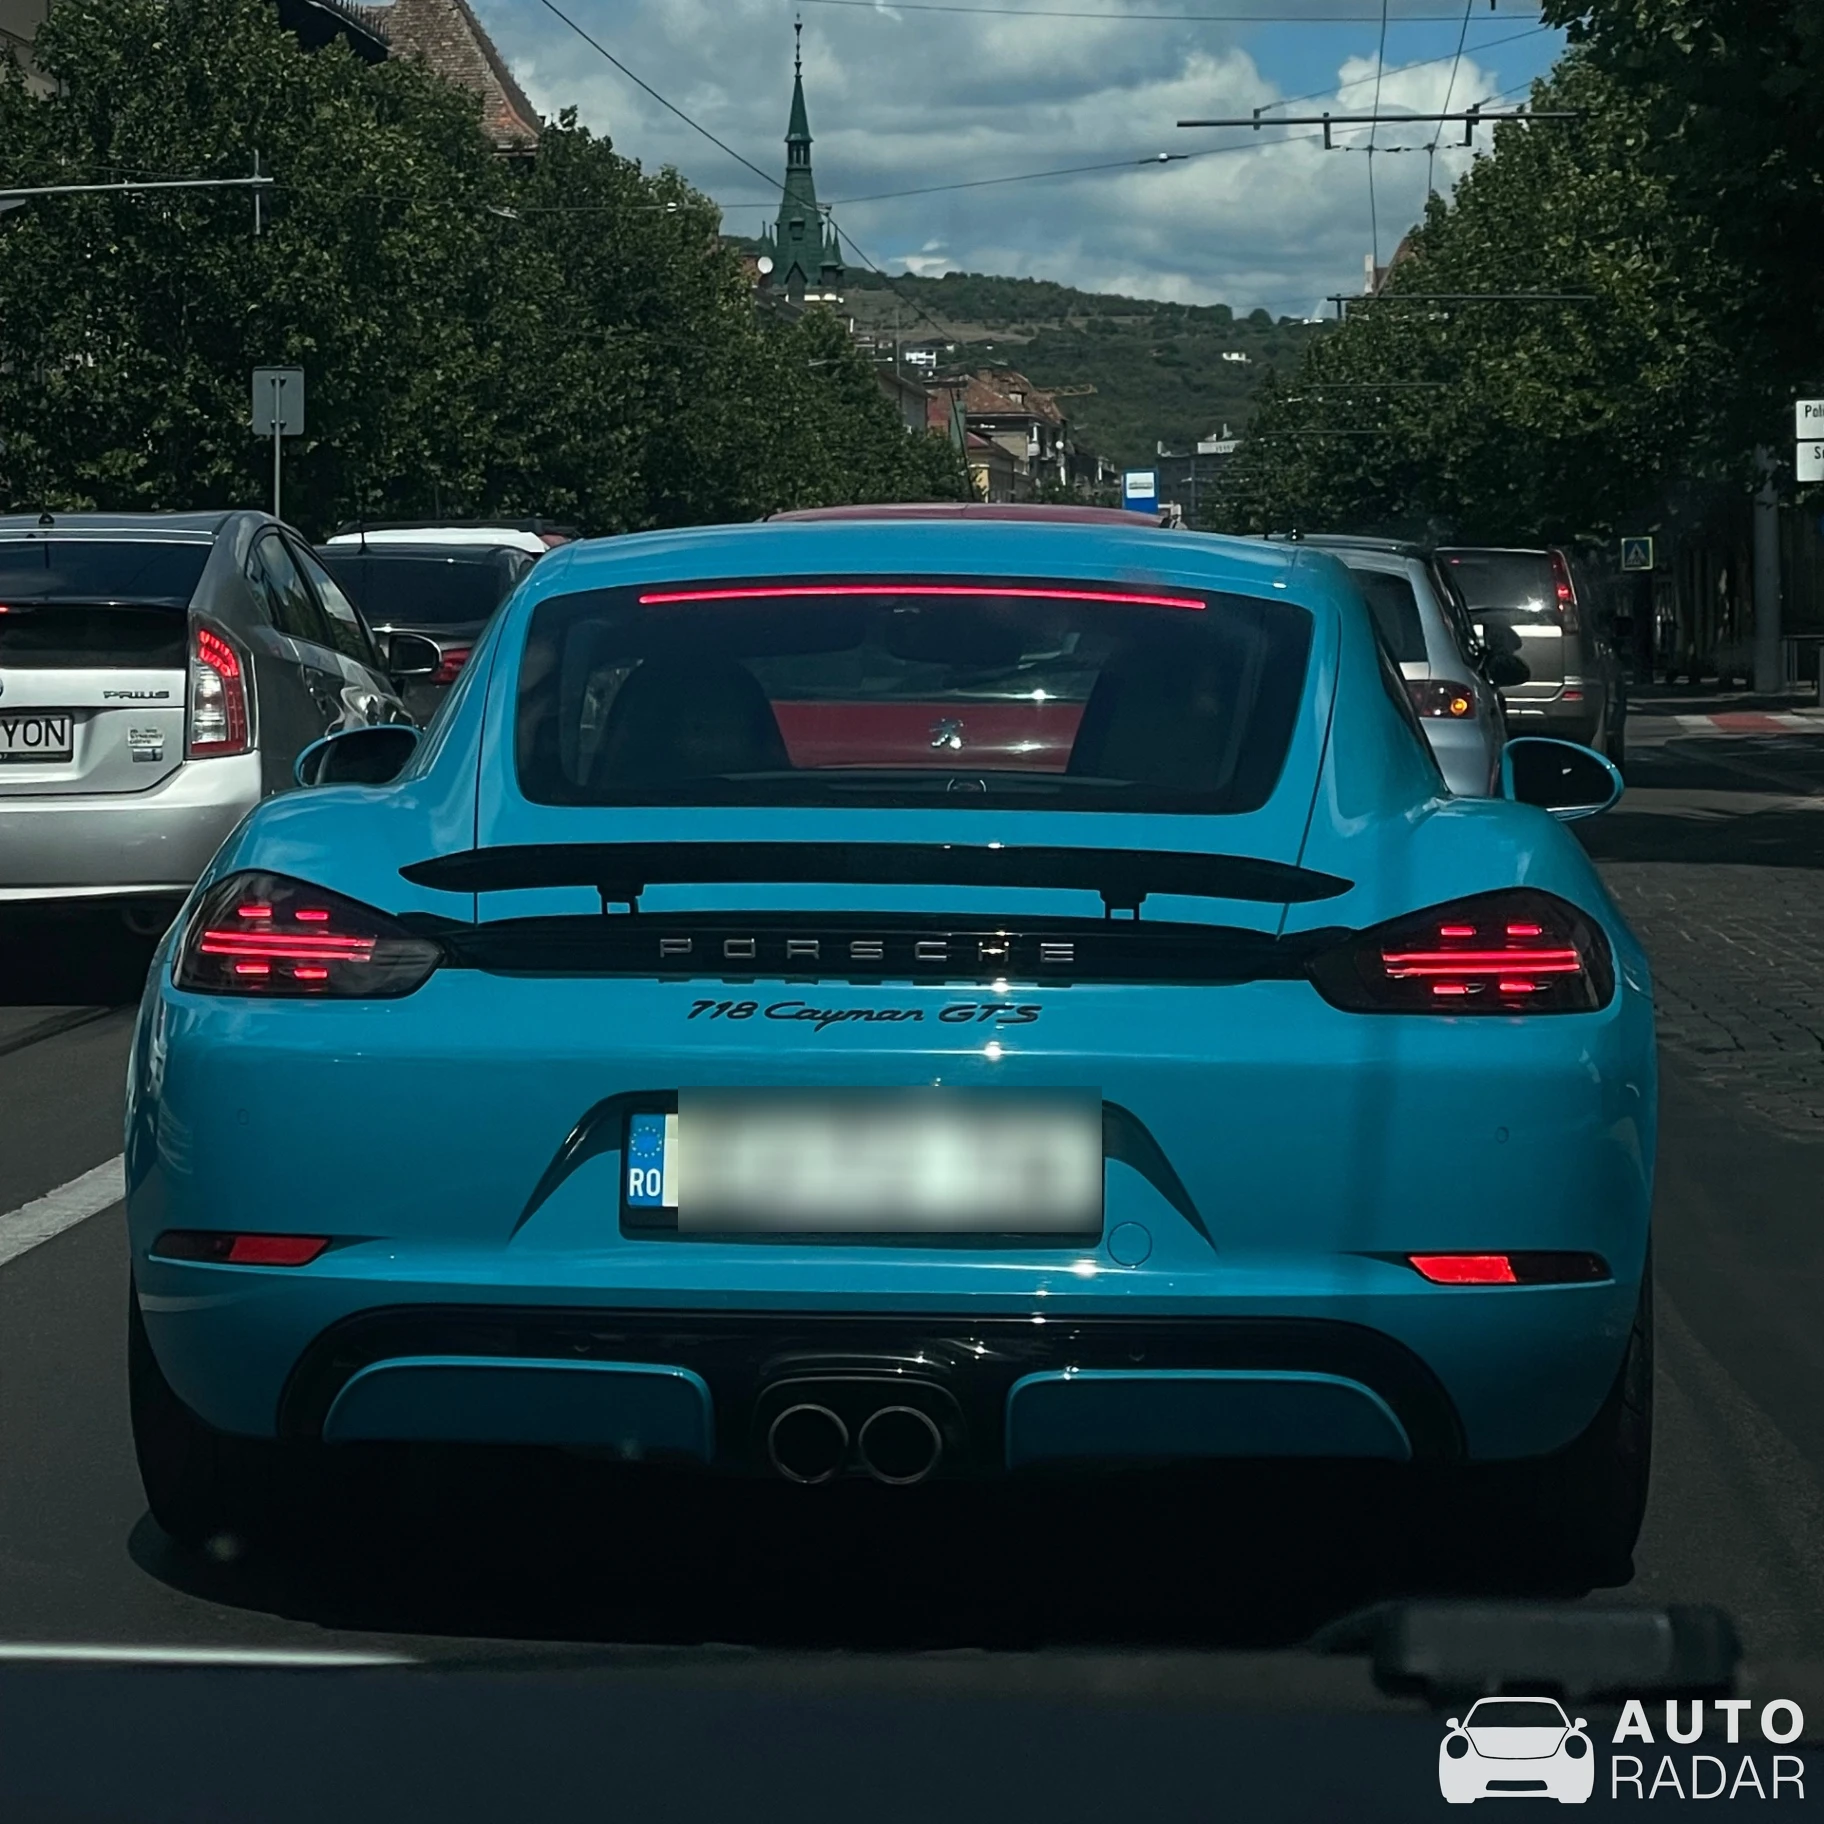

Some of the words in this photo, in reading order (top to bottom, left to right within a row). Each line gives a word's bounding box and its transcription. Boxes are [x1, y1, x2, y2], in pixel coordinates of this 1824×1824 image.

[103, 690, 169, 699] PRIUS
[660, 937, 1074, 962] PORSCHE
[687, 1000, 759, 1020] 718
[764, 1001, 925, 1033] Cayman
[938, 1003, 1043, 1024] GTS
[629, 1167, 661, 1197] RO
